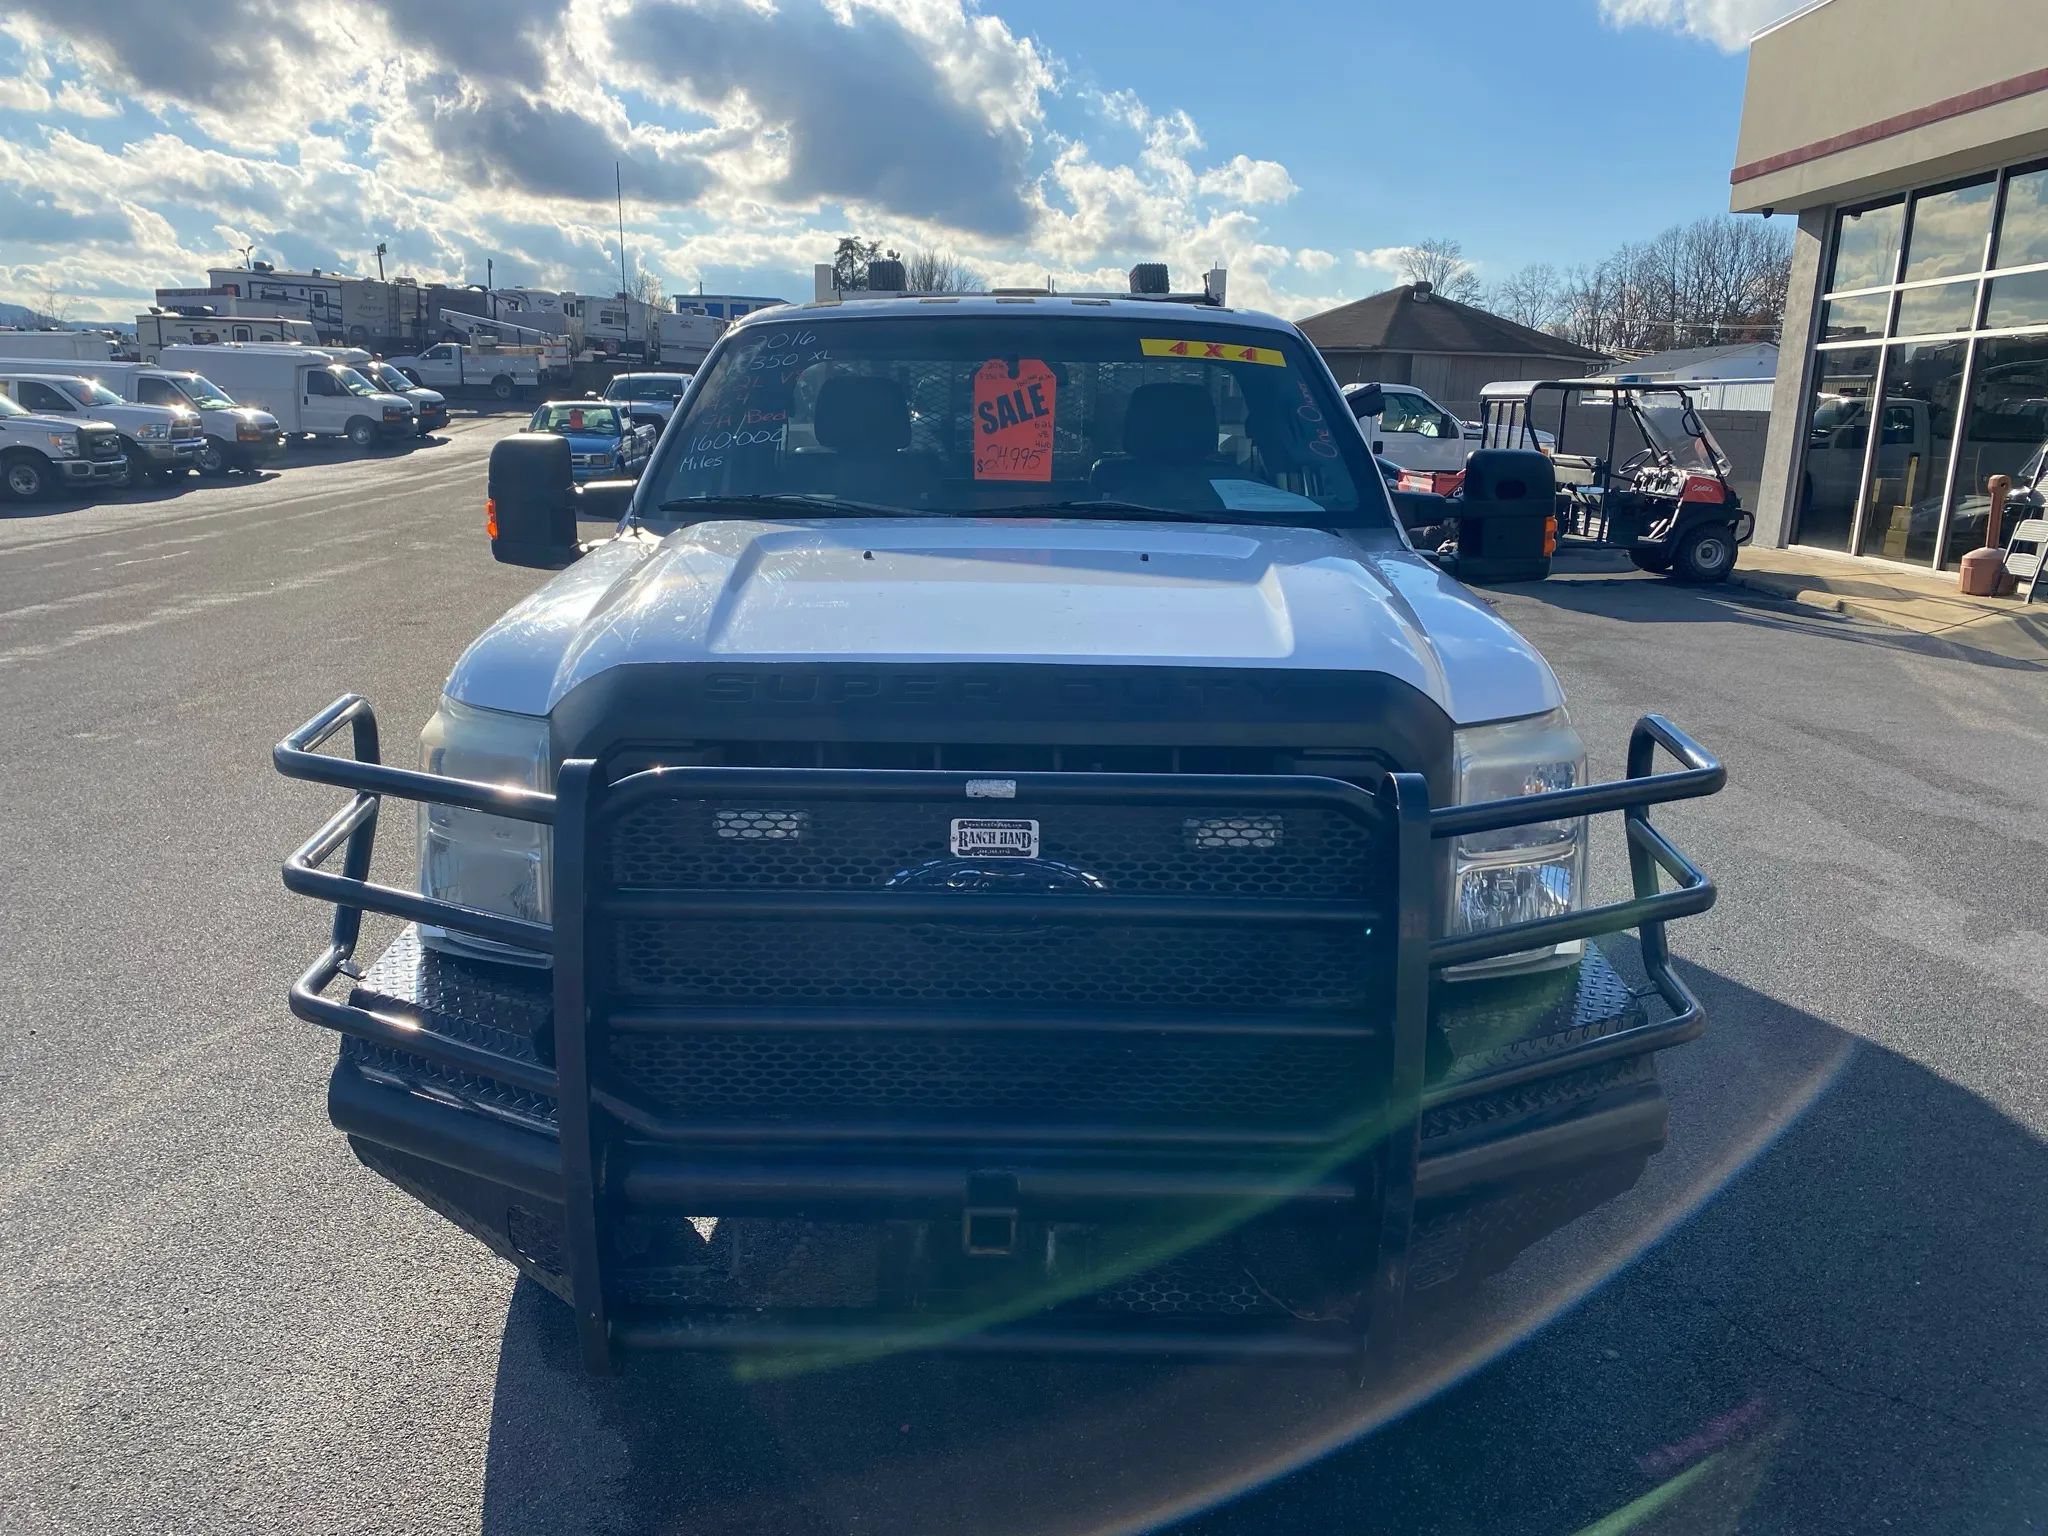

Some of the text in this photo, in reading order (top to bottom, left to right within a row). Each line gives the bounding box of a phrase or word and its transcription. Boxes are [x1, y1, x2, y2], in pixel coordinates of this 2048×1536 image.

[808, 350, 833, 361] XL
[1169, 341, 1188, 355] 4
[1238, 347, 1257, 361] 4
[747, 409, 788, 424] Bed
[978, 384, 1049, 434] SALE
[680, 455, 723, 473] Miles
[703, 672, 1005, 703] SUPER
[958, 831, 1031, 848] RANCH HAND
